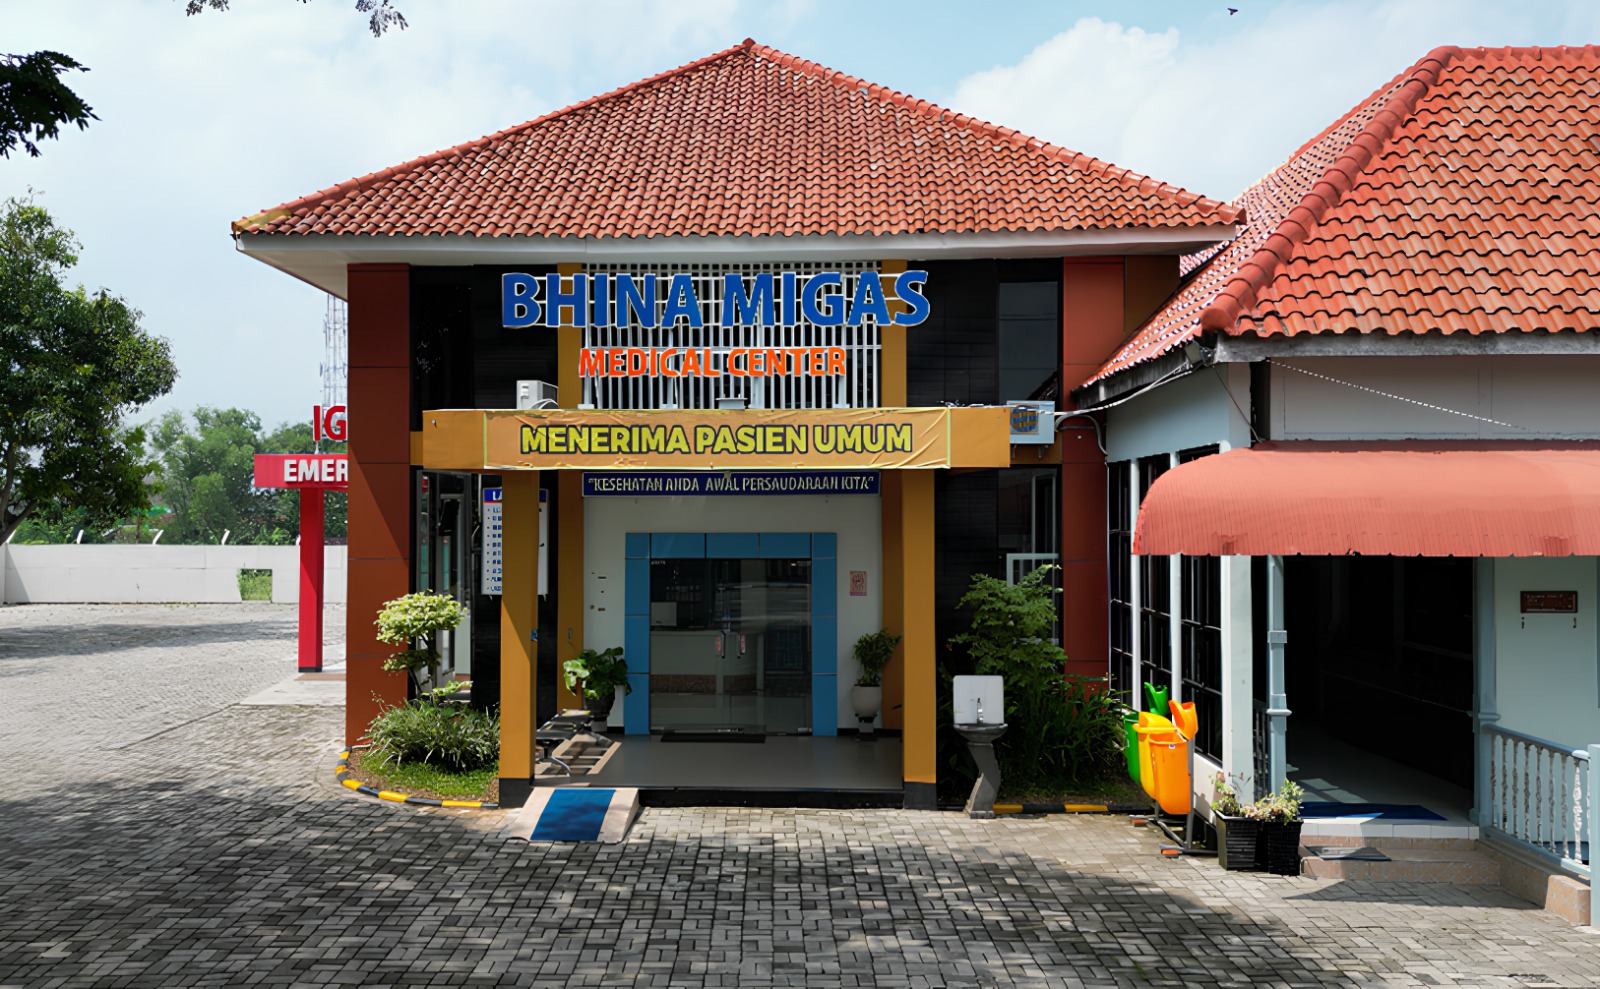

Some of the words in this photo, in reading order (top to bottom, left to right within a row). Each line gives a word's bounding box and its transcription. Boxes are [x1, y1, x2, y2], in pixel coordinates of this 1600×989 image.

[502, 272, 702, 328] BHINA
[722, 270, 930, 327] MIGAS
[579, 347, 721, 378] MEDICAL
[727, 347, 847, 377] CENTER
[521, 425, 690, 454] MENERIMA
[695, 424, 808, 454] PASIEN
[813, 423, 912, 453] UMUM
[705, 477, 739, 491] AWAL
[743, 476, 838, 491] PERSAUDARAAN
